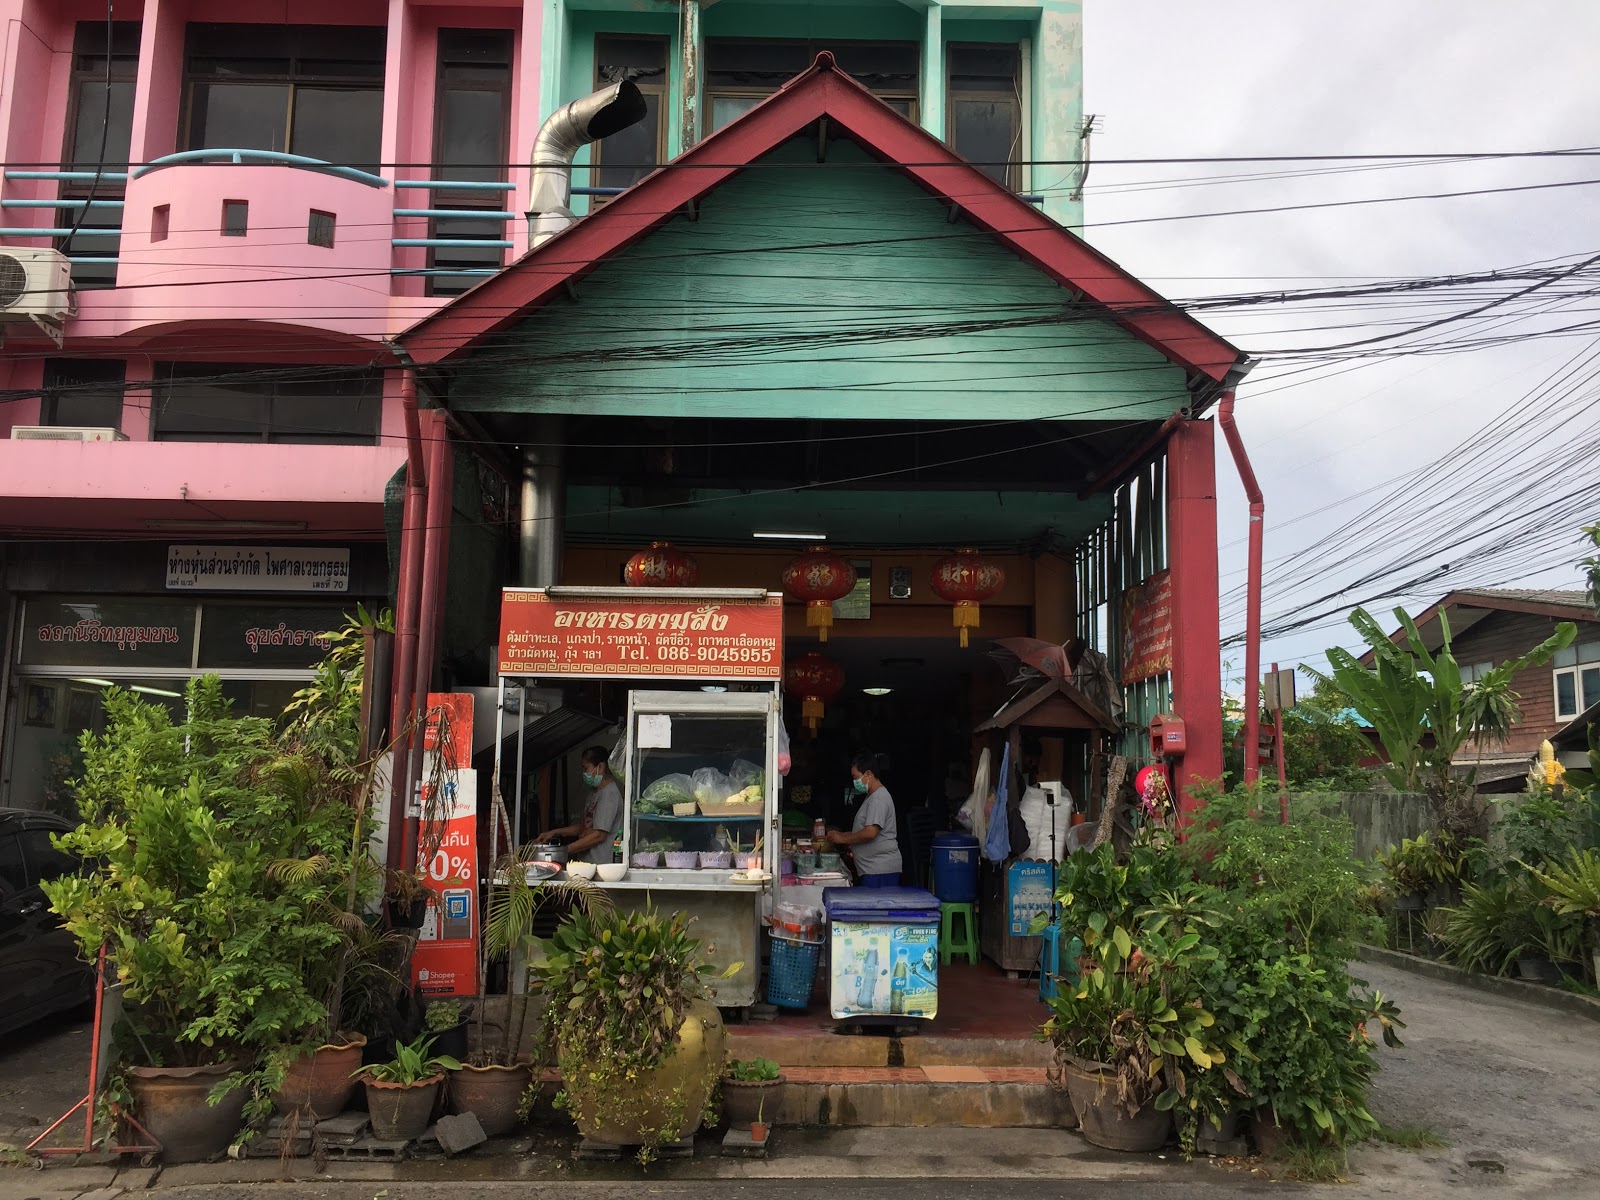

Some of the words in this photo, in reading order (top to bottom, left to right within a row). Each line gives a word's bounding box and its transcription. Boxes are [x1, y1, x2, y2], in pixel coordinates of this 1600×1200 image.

[168, 549, 260, 583] ห้างหุ้นส่วนจำกัด
[265, 551, 348, 577] ไพศาลเวชกรรม
[333, 580, 344, 588] 70
[554, 605, 730, 631] อาหารตามสั่ง
[38, 619, 179, 650] สถานีวิทยุชุมชน
[506, 630, 561, 645] ต้มยำทะเล,
[566, 630, 605, 646] แกงป่า,
[607, 632, 651, 646] ราดหน้า,
[698, 633, 776, 651] เกาหลาเลือดหมู
[507, 645, 560, 663] ข้าวผัดหมู,
[564, 645, 578, 662] กุ้ง
[582, 650, 602, 659] ฯลฯ
[616, 645, 650, 660] Tel.
[657, 646, 772, 663] 086-9045955
[430, 972, 455, 980] Shopee
